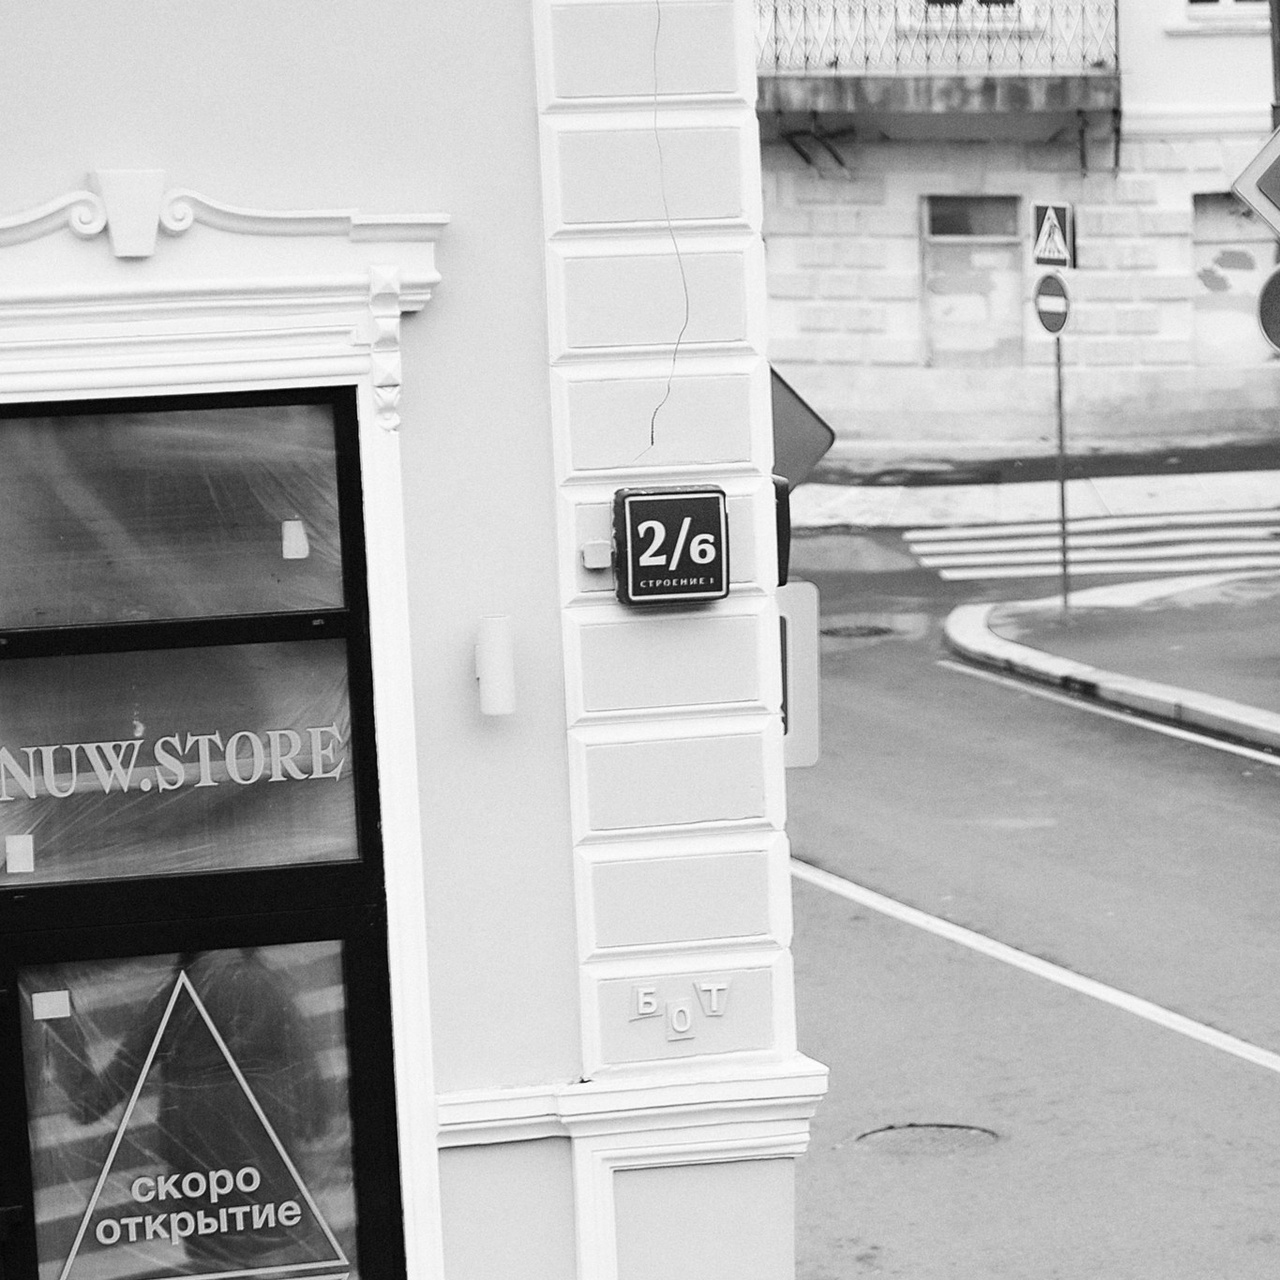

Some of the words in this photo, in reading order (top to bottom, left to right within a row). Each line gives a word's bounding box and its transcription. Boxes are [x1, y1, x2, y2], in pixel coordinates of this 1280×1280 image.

[637, 516, 717, 571] 2/6
[640, 577, 705, 588] СТРОЕНИЕ
[0, 722, 345, 800] NUW.STORE
[131, 1166, 261, 1203] скоро
[95, 1200, 302, 1245] открытие
